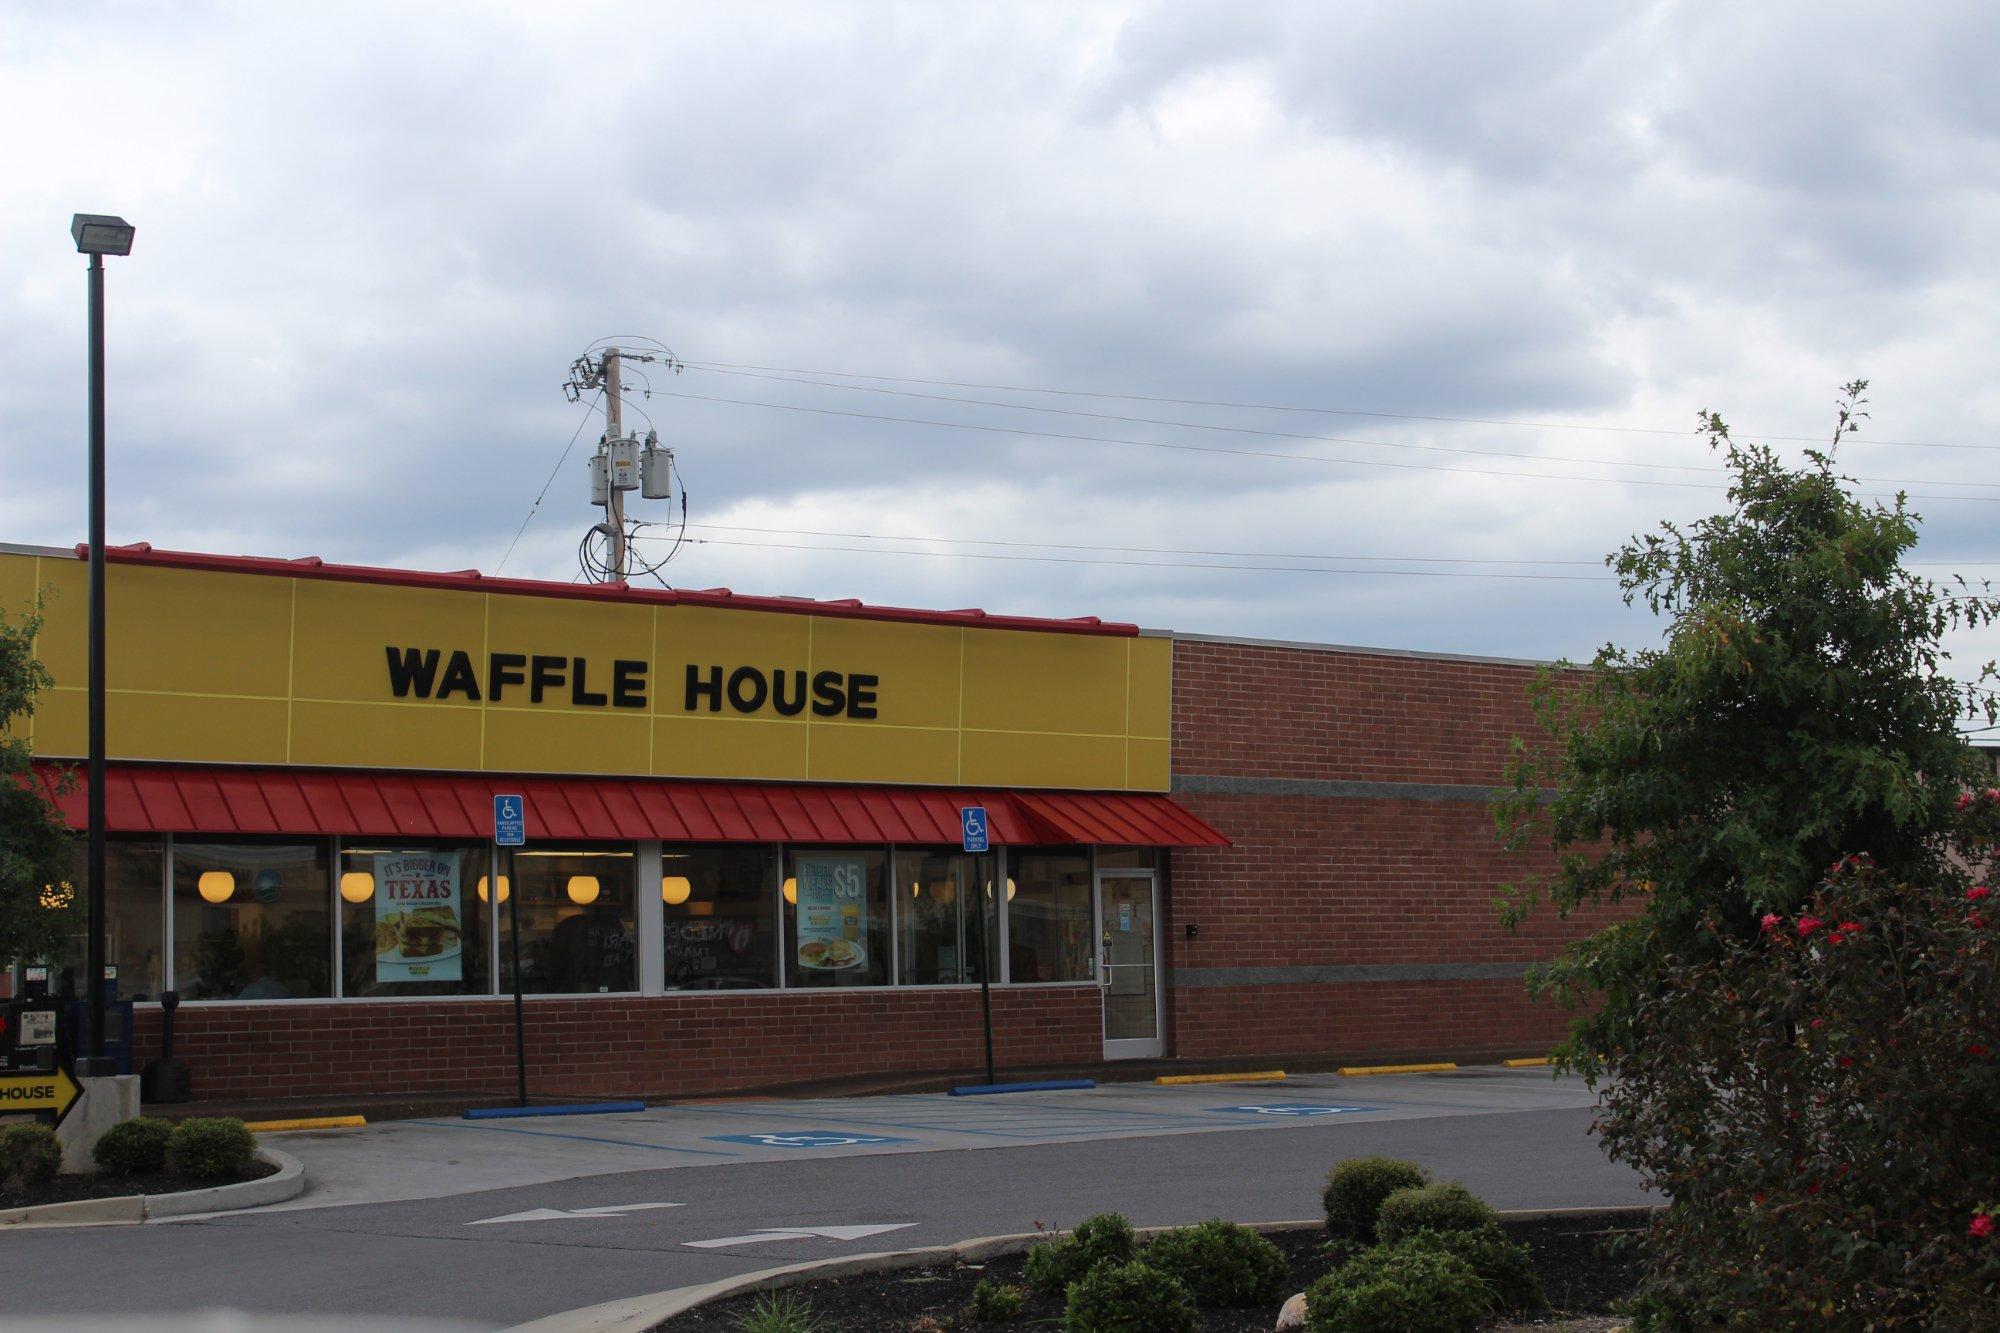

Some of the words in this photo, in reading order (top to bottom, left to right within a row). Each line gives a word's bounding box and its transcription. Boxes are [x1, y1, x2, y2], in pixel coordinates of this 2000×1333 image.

[385, 646, 648, 708] WAFFLE
[684, 664, 879, 719] HOUSE
[384, 861, 402, 877] IT'S
[403, 858, 436, 873] BIGGER
[437, 861, 452, 878] ON
[384, 880, 452, 899] TEXAS
[833, 864, 860, 898] $5
[0, 1085, 55, 1100] HOUSE
